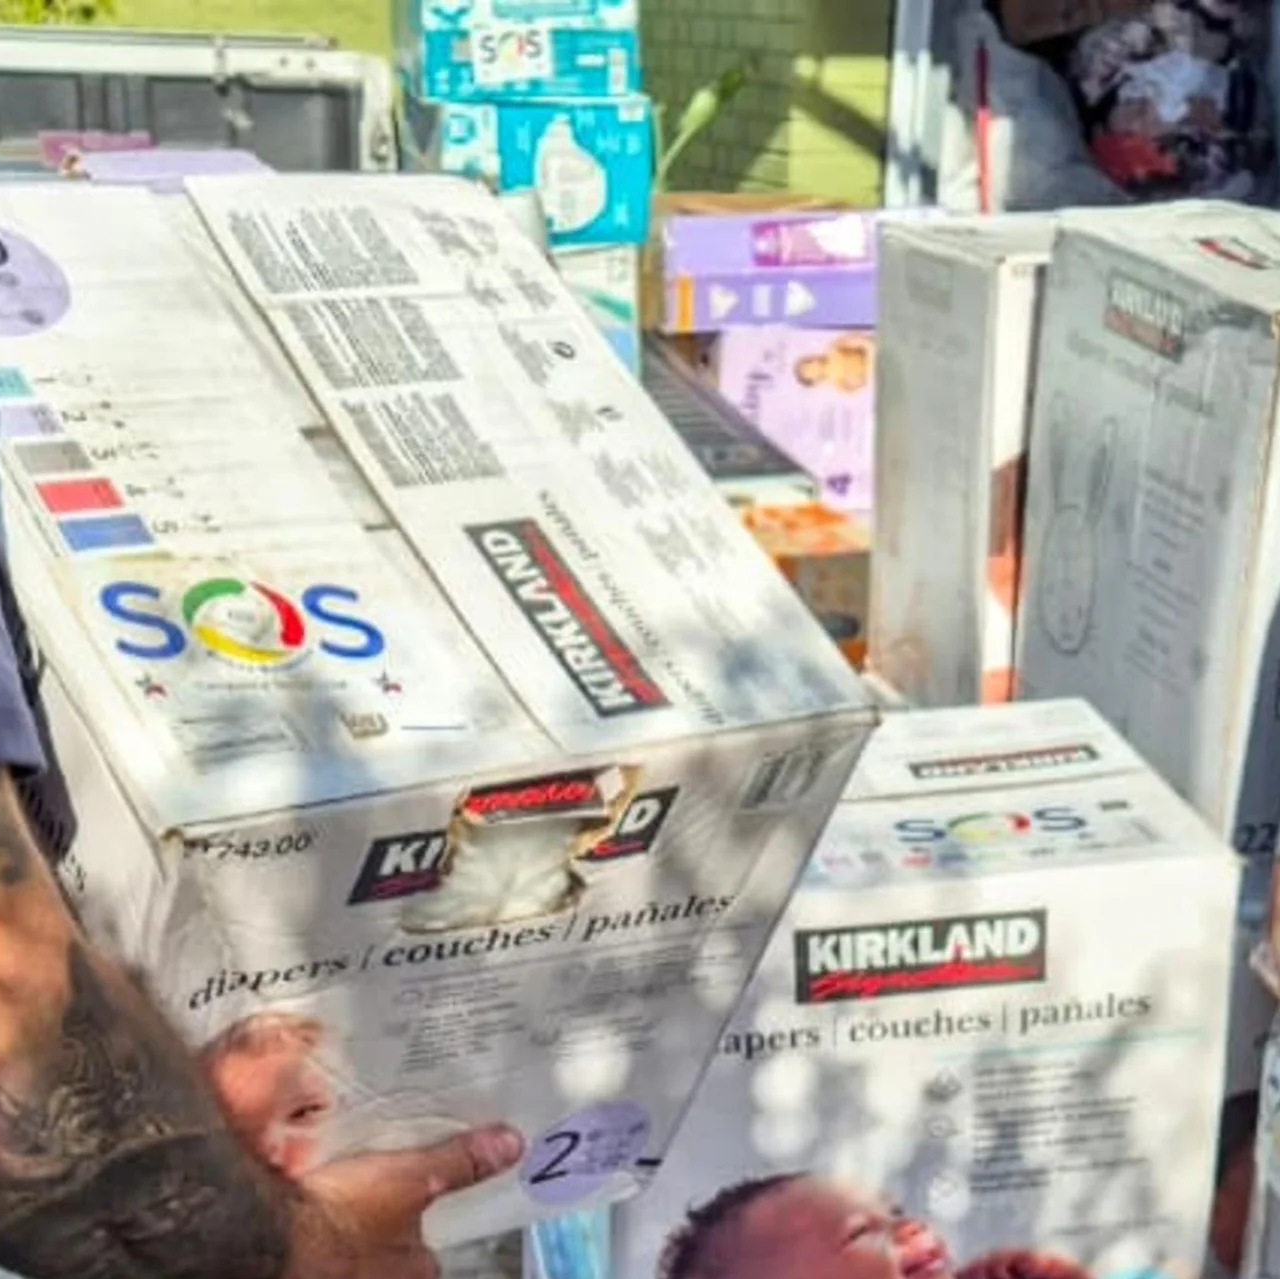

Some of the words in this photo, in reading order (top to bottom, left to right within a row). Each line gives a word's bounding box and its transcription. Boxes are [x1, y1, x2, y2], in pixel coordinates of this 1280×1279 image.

[100, 577, 385, 664] SOS
[481, 528, 635, 711] KIRKLAND
[187, 950, 351, 1011] diapers
[382, 920, 556, 970] couches
[807, 917, 1041, 976] KIRKLAND
[723, 1024, 821, 1058] apers
[848, 1003, 992, 1045] couches
[529, 1130, 581, 1185] 2
